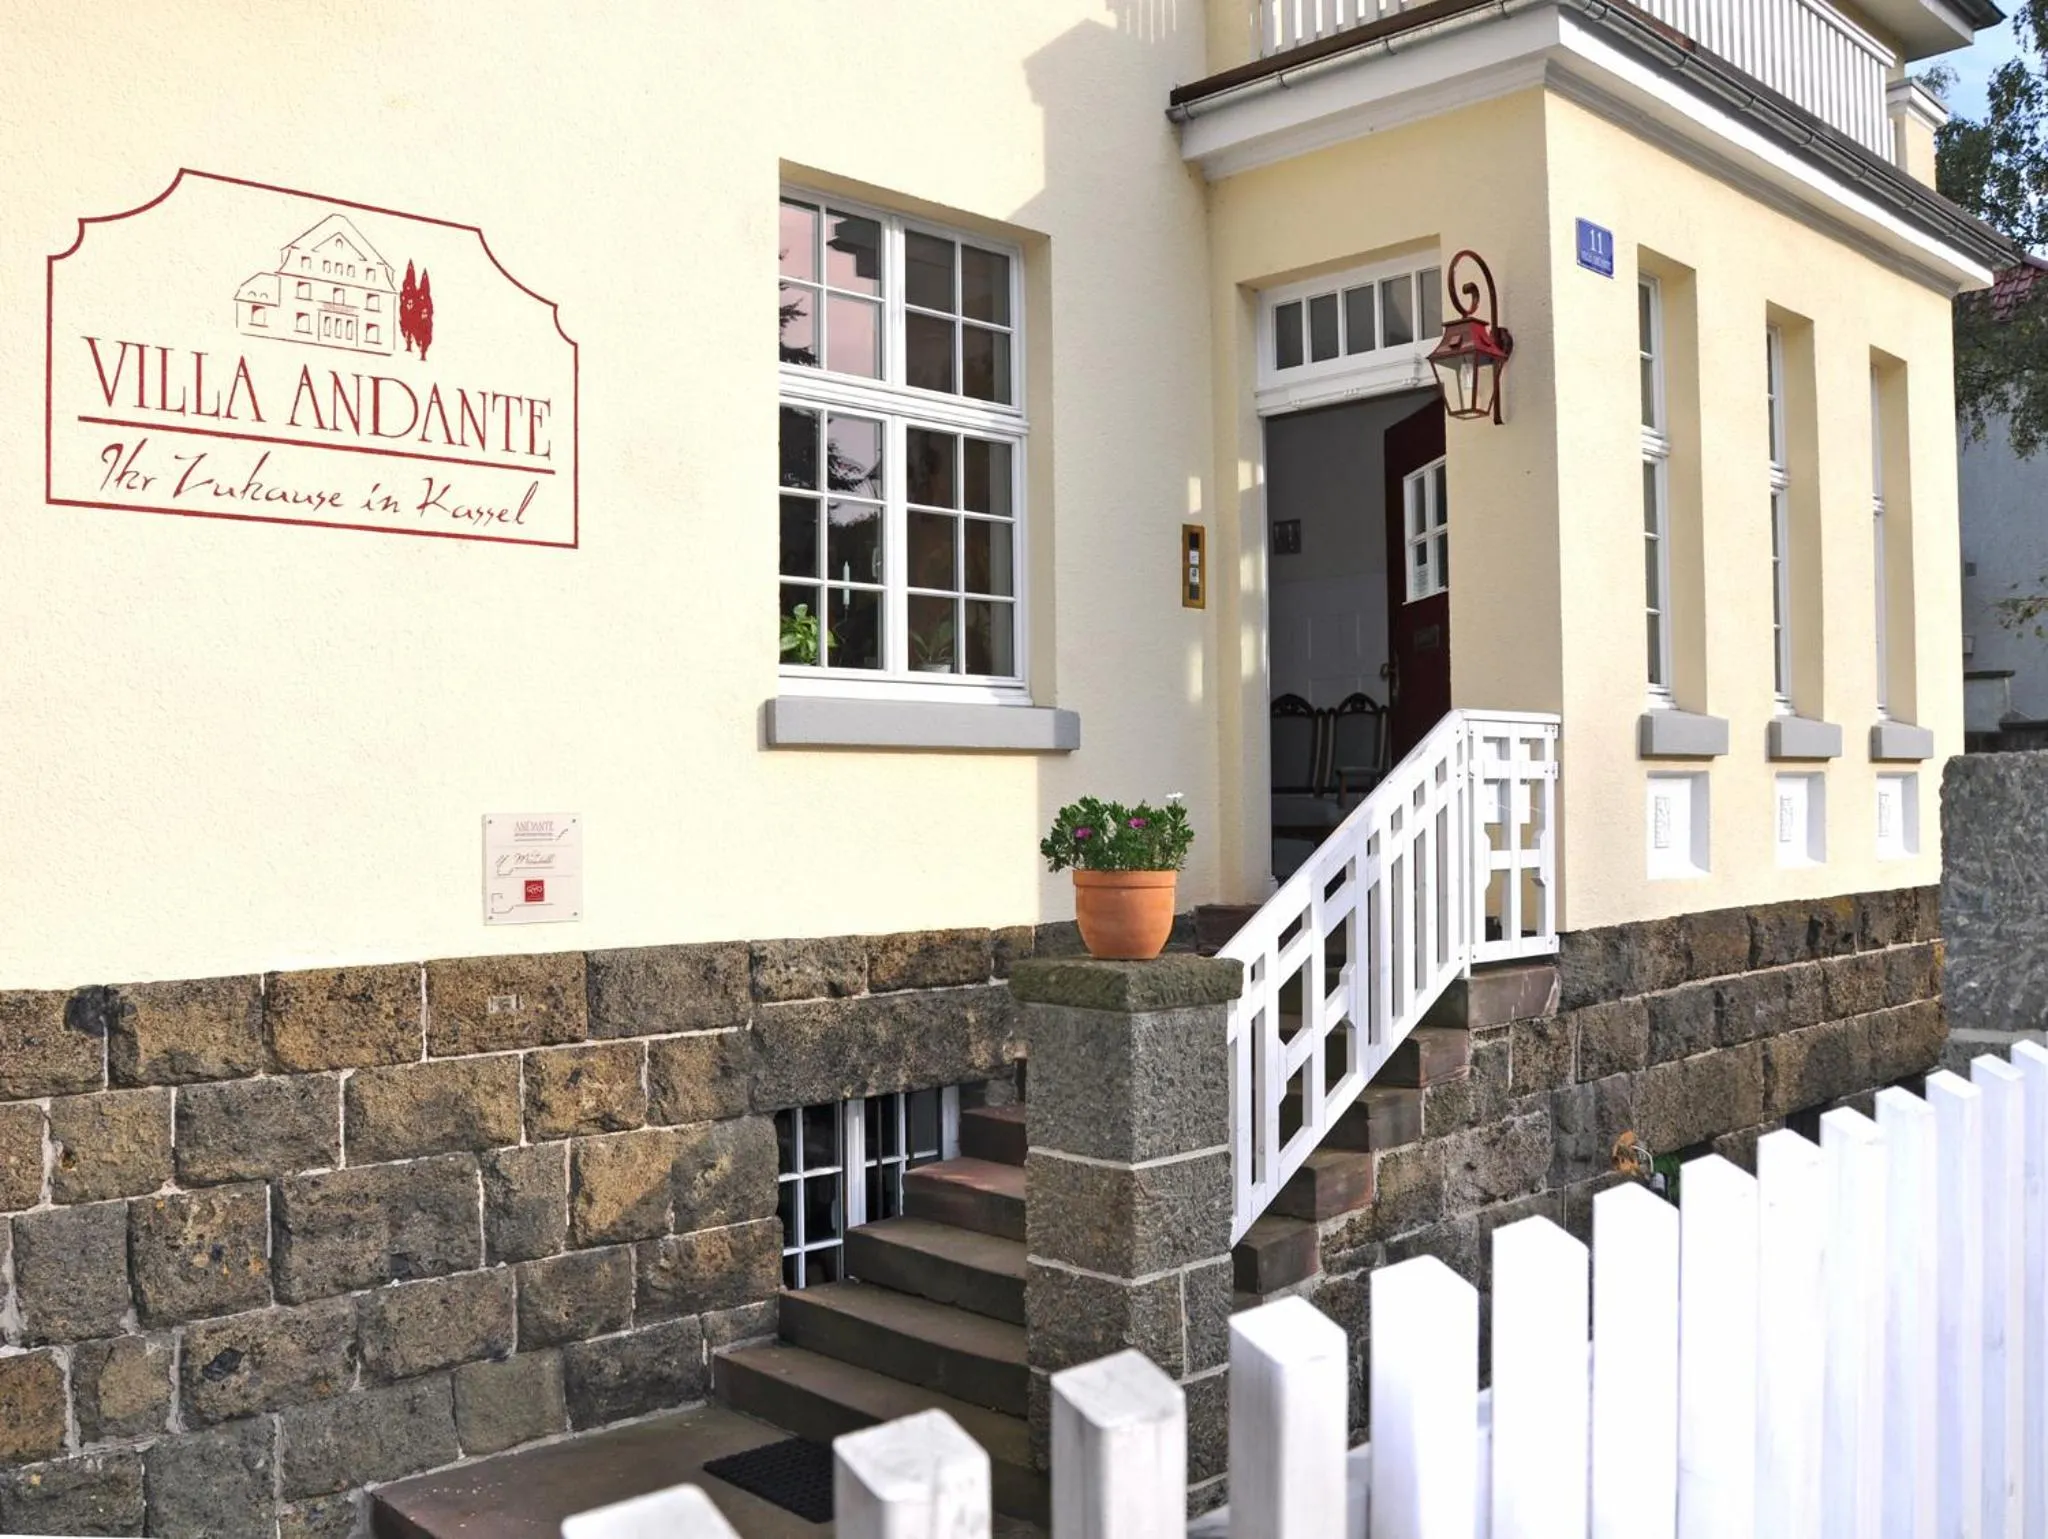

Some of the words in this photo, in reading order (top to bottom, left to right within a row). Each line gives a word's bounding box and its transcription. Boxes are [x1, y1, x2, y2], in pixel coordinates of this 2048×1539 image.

[1590, 229, 1604, 254] 11
[81, 336, 267, 424] VILLA
[288, 363, 551, 459] ANDANTE
[101, 438, 157, 491] Ihr
[173, 450, 343, 508] Zuhause
[359, 483, 400, 513] in
[416, 477, 538, 525] Kassel
